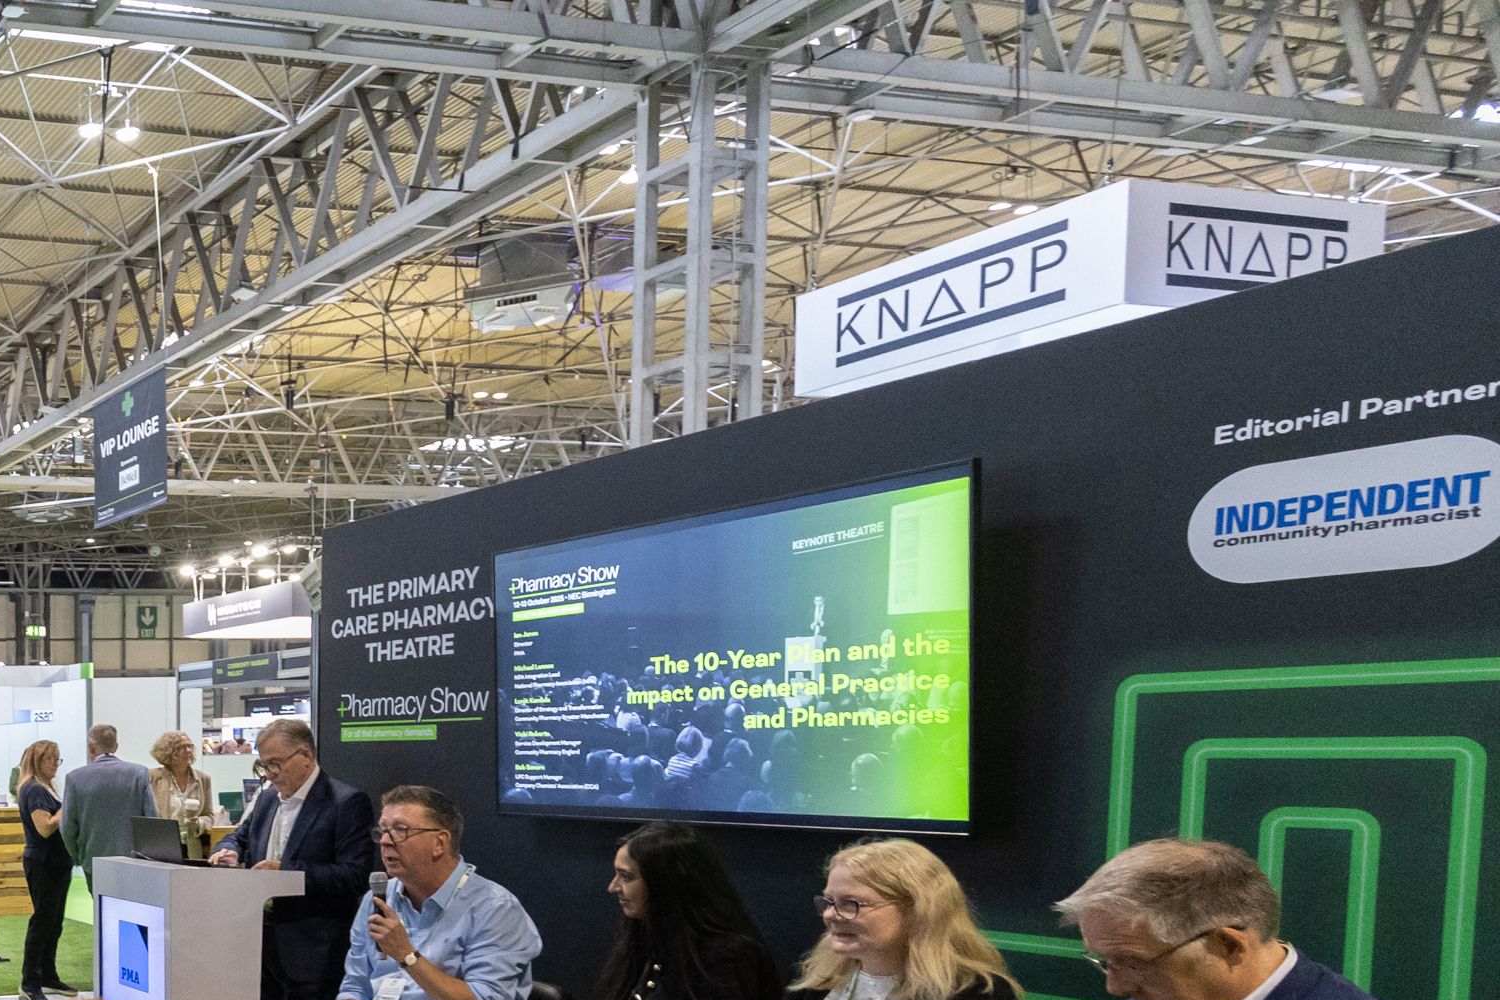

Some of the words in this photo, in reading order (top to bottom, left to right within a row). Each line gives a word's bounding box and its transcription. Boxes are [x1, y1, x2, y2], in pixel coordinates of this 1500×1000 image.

[1166, 220, 1348, 278] KNAPP
[835, 239, 1069, 353] KNAPP
[1213, 401, 1349, 445] Editorial
[1359, 379, 1500, 420] Partner
[100, 437, 116, 458] VIP
[117, 415, 159, 451] LOUNGE
[1214, 470, 1491, 536] INDEPENDENT
[792, 532, 835, 551] KEYNOTE
[835, 521, 885, 541] THEATRE
[347, 583, 385, 608] THE
[387, 565, 480, 602] PRIMARY
[510, 572, 576, 594] Pharmacy
[577, 565, 620, 584] Show
[140, 629, 155, 638] EXIT
[331, 613, 379, 639] CARE
[365, 633, 455, 663] THEATRE
[649, 654, 690, 675] The
[693, 649, 782, 672] 10-Year
[788, 642, 841, 665] Plan
[847, 635, 896, 661] and
[902, 632, 951, 657] the
[338, 693, 427, 723] Pharmacy
[430, 686, 490, 714] Show
[626, 685, 694, 710] impact
[698, 685, 726, 701] on
[729, 673, 826, 700] General
[831, 669, 951, 695] Practice
[742, 706, 785, 729] and
[791, 703, 950, 728] Pharmacies
[121, 966, 140, 985] PMA
